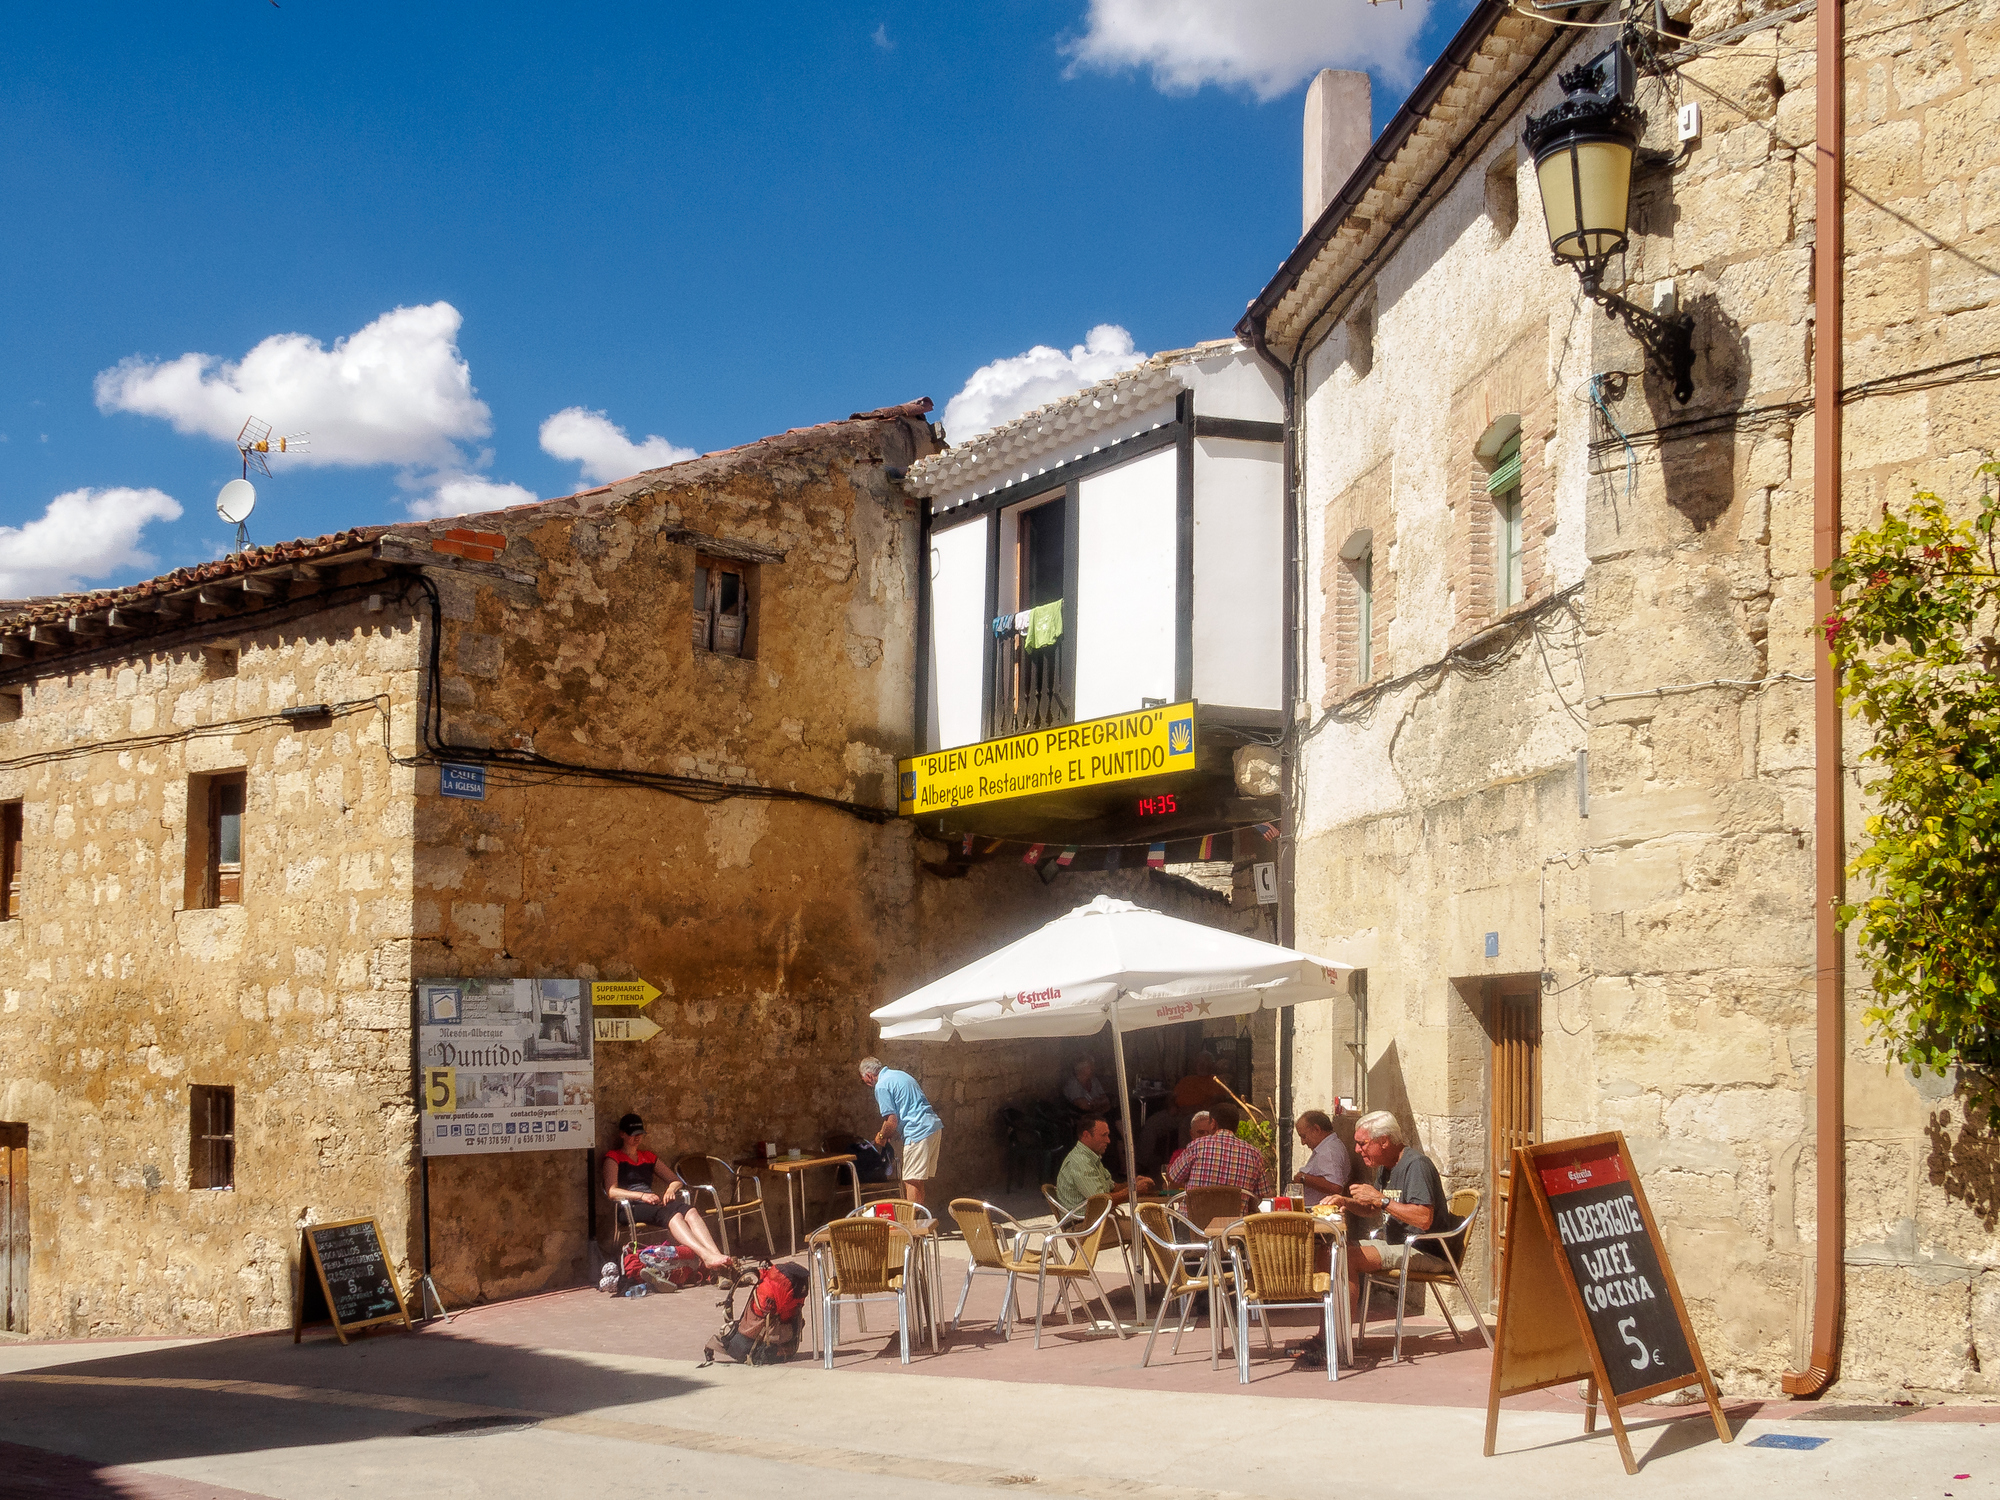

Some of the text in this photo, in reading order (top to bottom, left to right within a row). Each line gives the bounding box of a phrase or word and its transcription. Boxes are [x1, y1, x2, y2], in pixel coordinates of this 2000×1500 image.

[920, 712, 1163, 776] "BUEN CAMINO PEREGRINO"
[444, 780, 482, 793] LA IGLESIA
[920, 745, 1165, 807] Albergue Restaurante EL PUNTIDO
[1139, 794, 1176, 816] 14:35
[1016, 986, 1062, 1005] Estrella
[598, 1020, 631, 1039] WIFI
[428, 1042, 522, 1067] el Puntido
[432, 1071, 450, 1108] 5
[433, 1111, 494, 1121] www.puntido.com
[477, 1137, 487, 1145] 947
[488, 1136, 499, 1145] 378
[500, 1135, 511, 1144] 597
[1557, 1195, 1643, 1245] ALBERGUE
[1581, 1241, 1636, 1284] WIFI
[1583, 1275, 1655, 1313] COCINA
